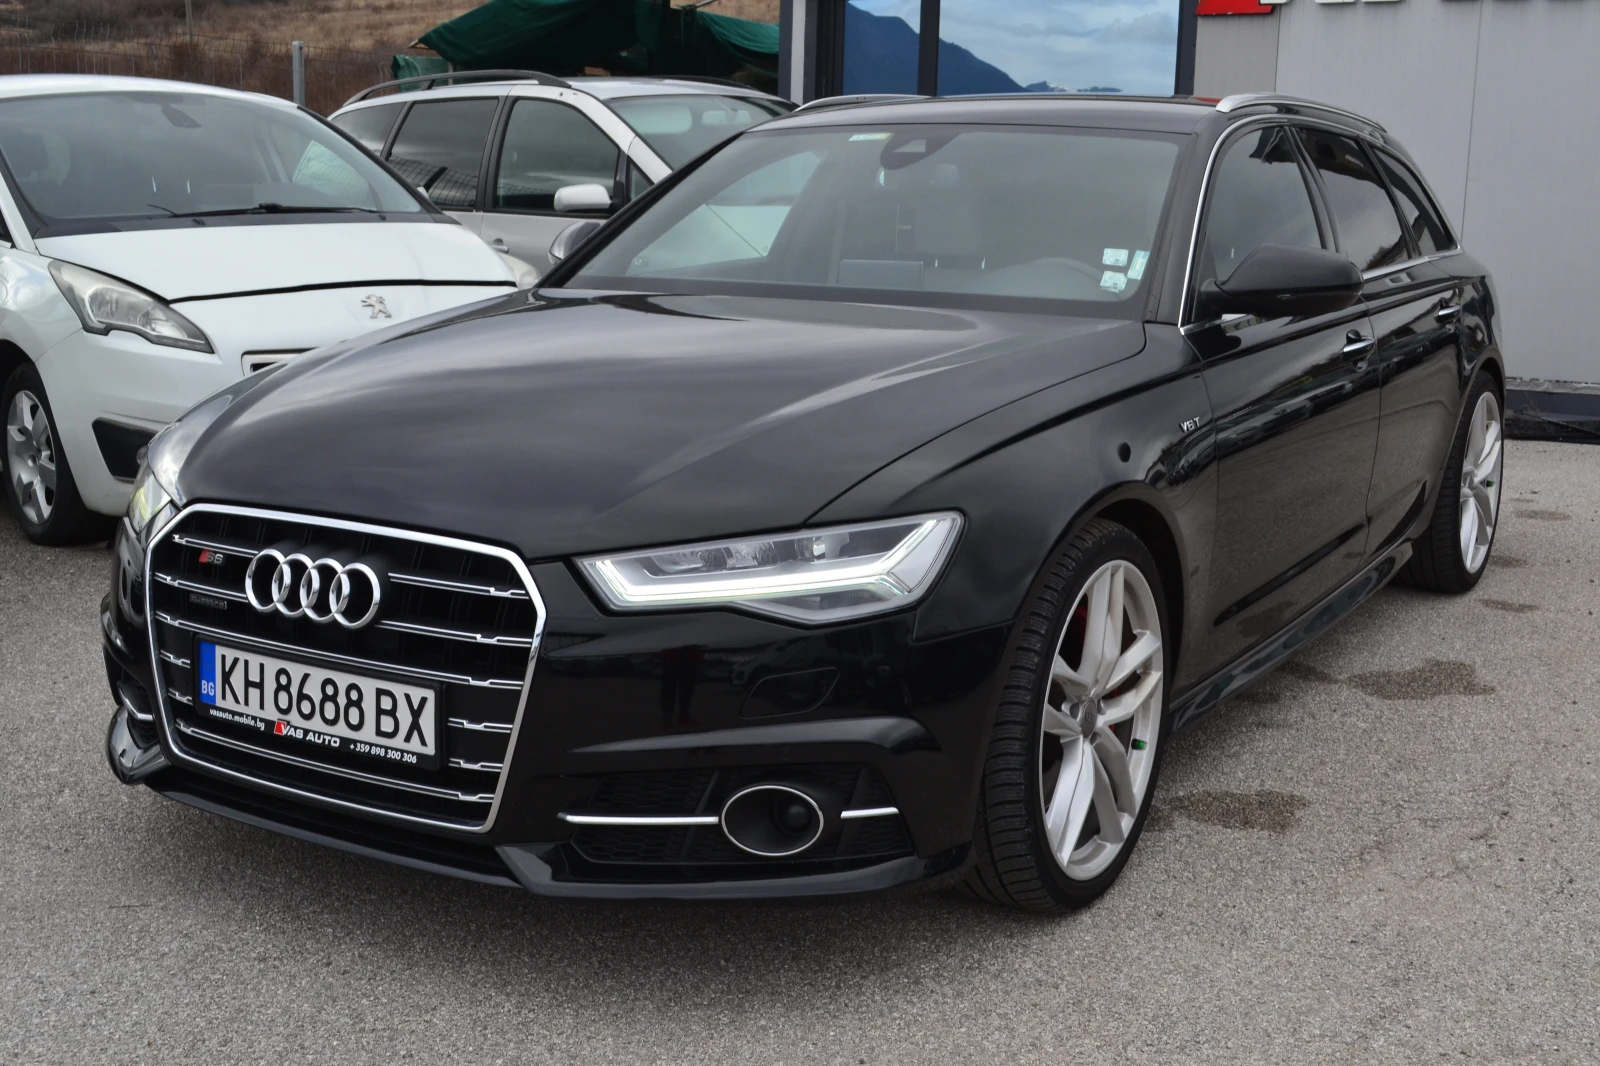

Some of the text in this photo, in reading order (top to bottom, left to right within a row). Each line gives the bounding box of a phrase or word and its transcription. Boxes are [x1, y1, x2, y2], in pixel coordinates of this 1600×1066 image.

[1180, 416, 1200, 433] V6T
[204, 551, 224, 564] S6
[201, 679, 215, 697] BG
[209, 708, 265, 731] vasauto.mobile.bg
[280, 724, 340, 748] VAS AUTO
[370, 746, 385, 757] 898
[386, 749, 401, 760] 300
[402, 753, 417, 764] 306
